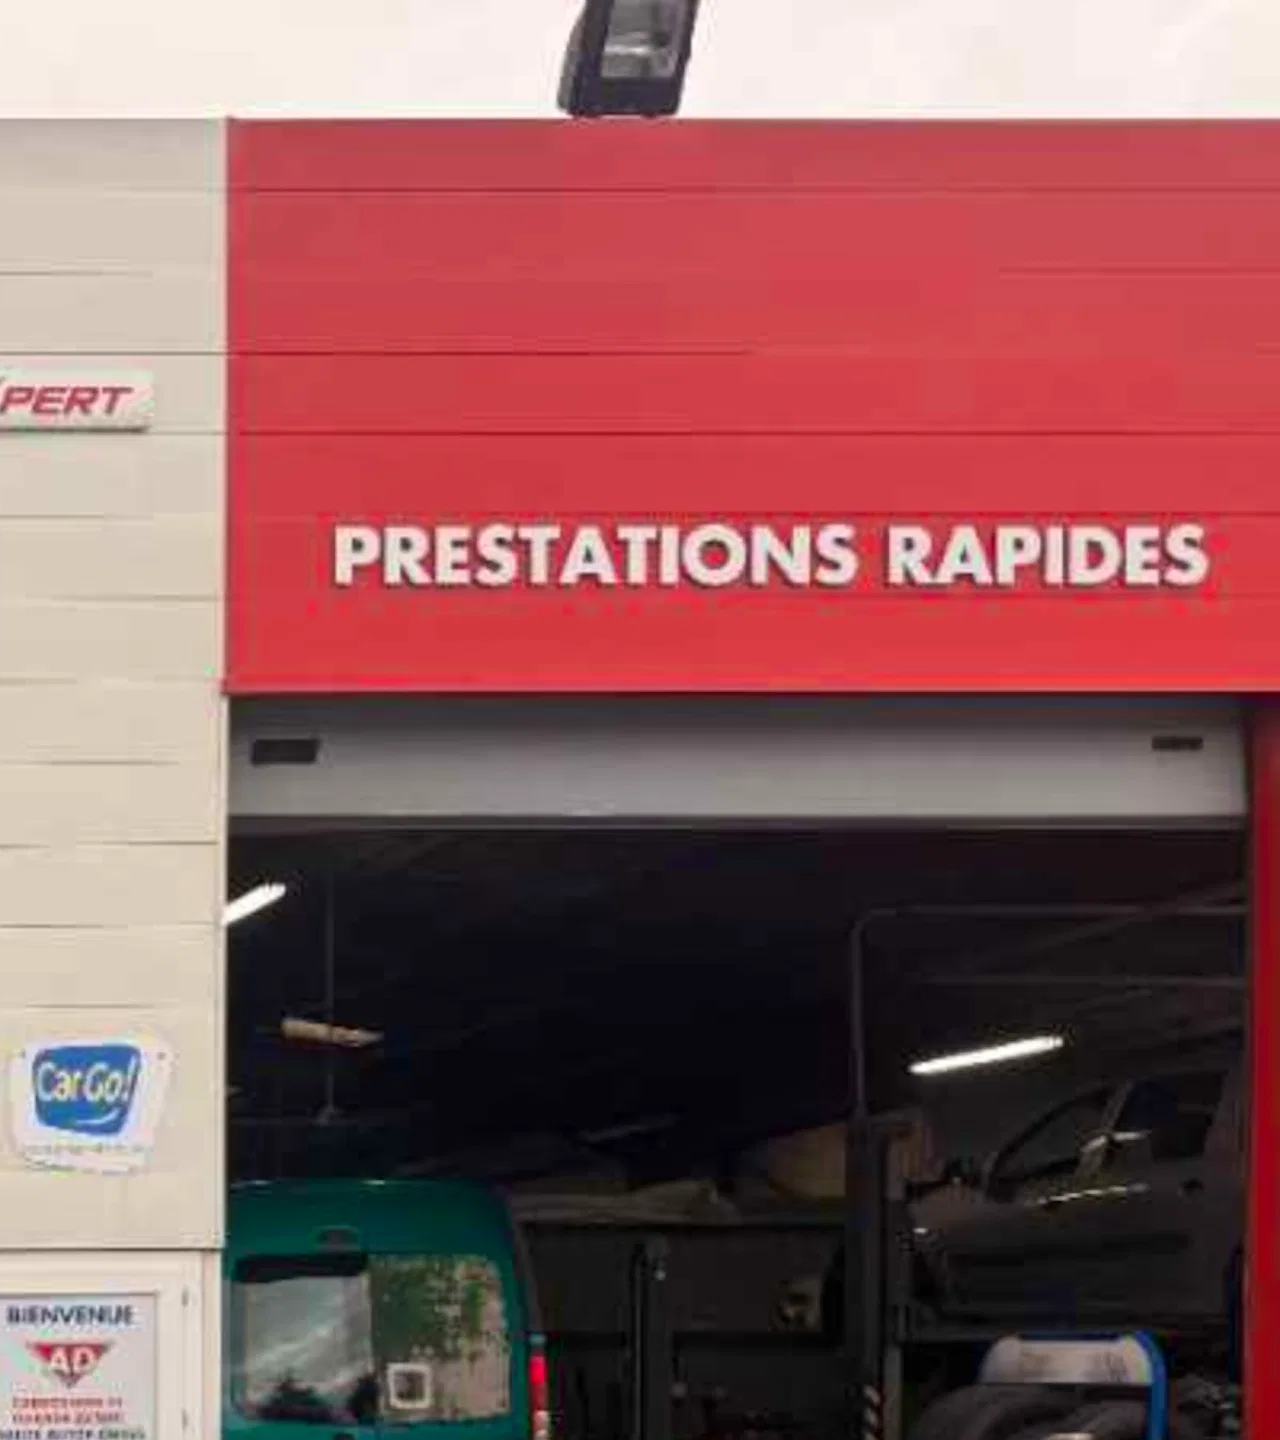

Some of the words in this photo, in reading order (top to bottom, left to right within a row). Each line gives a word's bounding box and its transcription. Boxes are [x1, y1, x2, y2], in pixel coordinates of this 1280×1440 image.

[333, 524, 859, 586] PRESTATIONS
[886, 524, 1211, 586] RAPIDES
[6, 1305, 134, 1323] BIENVENUE
